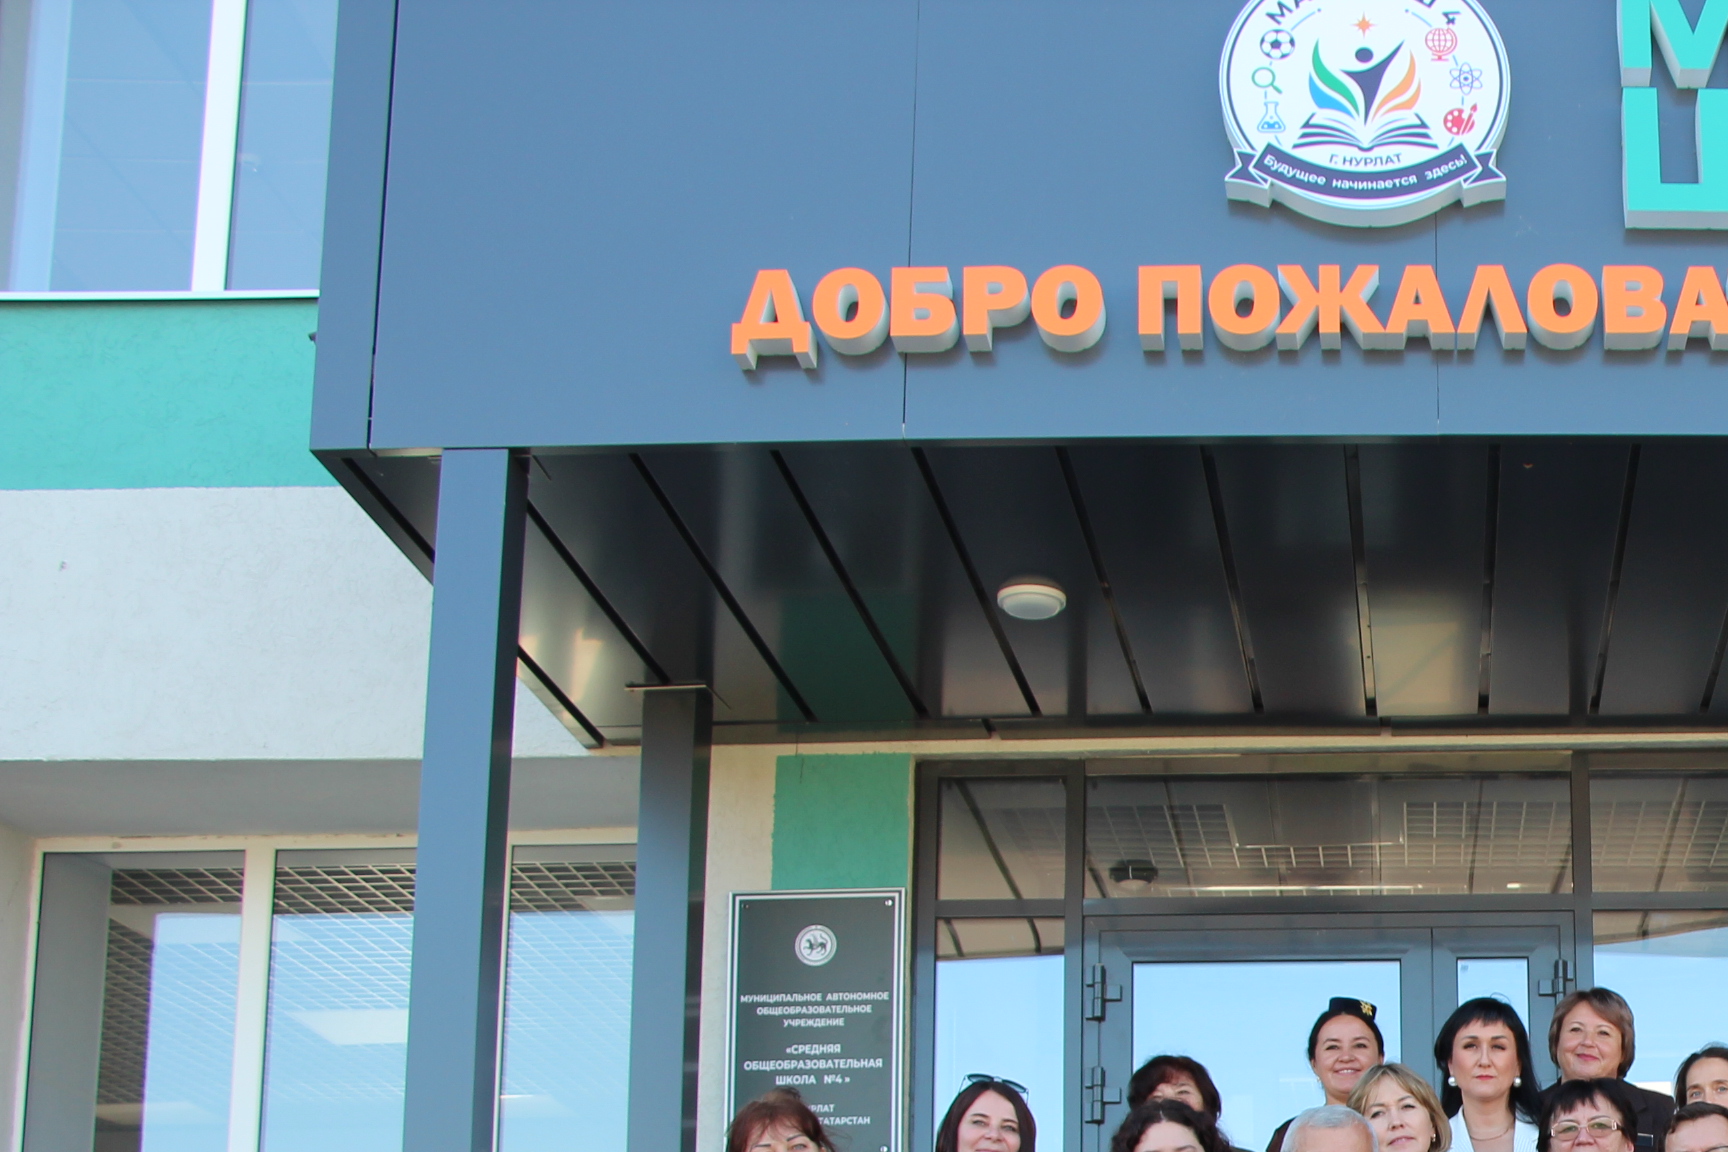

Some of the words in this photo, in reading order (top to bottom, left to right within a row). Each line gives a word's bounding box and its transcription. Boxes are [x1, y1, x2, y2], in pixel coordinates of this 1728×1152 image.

[1342, 153, 1403, 167] НУРЛАТ
[1263, 154, 1326, 186] Будущее
[1332, 174, 1418, 190] начинается
[1425, 154, 1468, 181] здесь!
[731, 266, 1104, 366] ДОБРО
[740, 993, 822, 1003] МУНИЦИПАЛЬНОЕ
[826, 992, 889, 1001] АВТОНОМНОЕ
[756, 1004, 872, 1016] ОБЩЕОБРАЗОВАТЕЛЬНОЕ
[783, 1018, 845, 1028] УЧРЕЖДЕНИЕ
[786, 1044, 841, 1055] «СРЕДНЯЯ
[743, 1058, 883, 1071] ОБЩЕОБРАЗОВАТЕЛЬНАЯ
[776, 1075, 816, 1085] ШКОЛА
